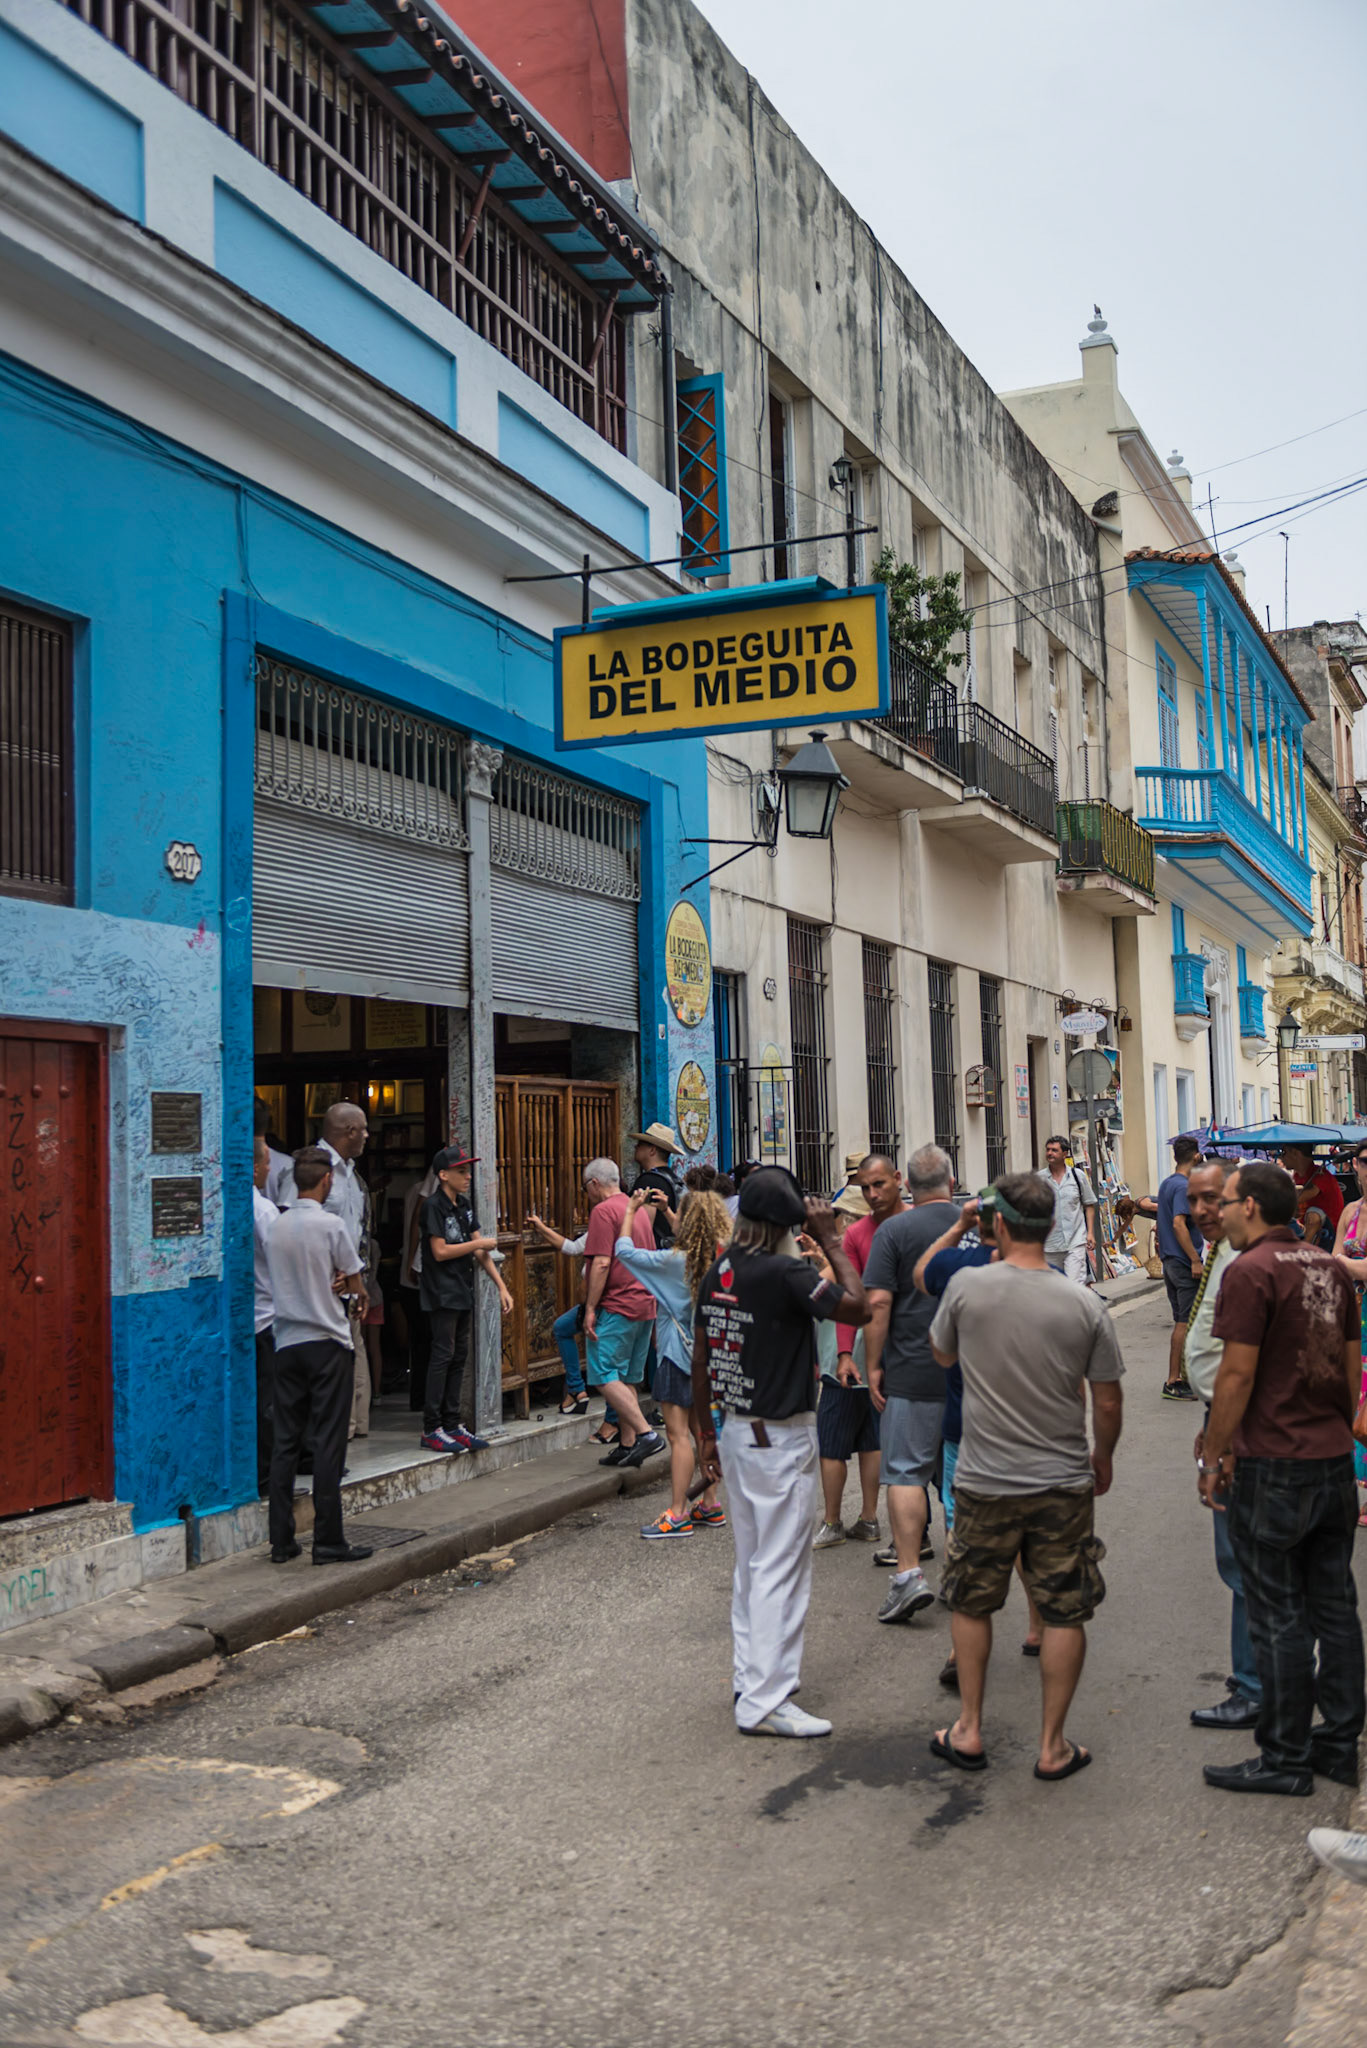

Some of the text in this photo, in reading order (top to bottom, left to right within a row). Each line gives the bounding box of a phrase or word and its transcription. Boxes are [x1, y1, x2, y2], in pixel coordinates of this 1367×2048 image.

[588, 621, 854, 682] LA BODEGUITA
[588, 655, 858, 720] DEL MEDIO
[174, 850, 196, 875] 207
[669, 934, 706, 960] LA BODEGUITA
